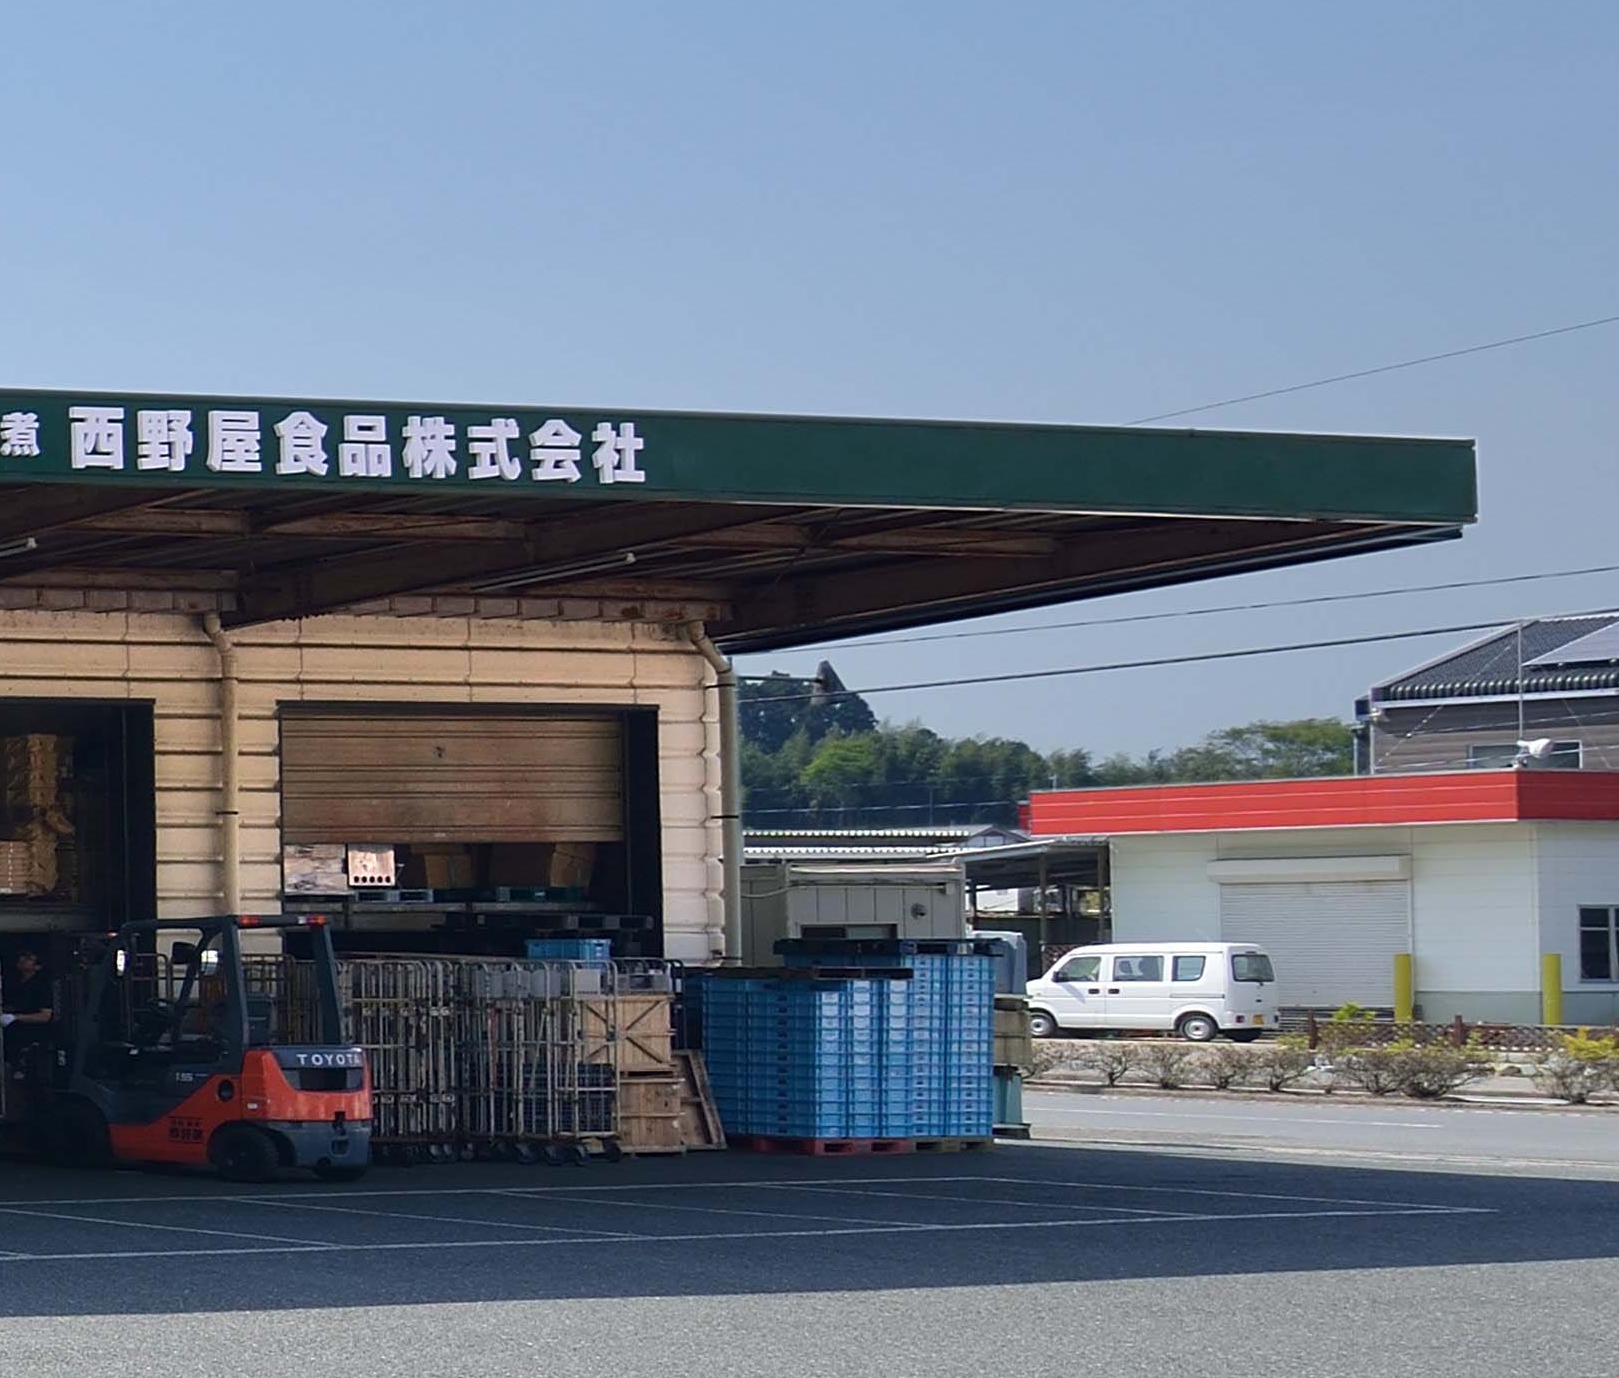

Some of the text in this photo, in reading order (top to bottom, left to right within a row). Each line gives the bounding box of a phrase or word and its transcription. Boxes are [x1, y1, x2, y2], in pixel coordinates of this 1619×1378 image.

[69, 405, 646, 484] 西野屋食品株式会社
[296, 1053, 361, 1065] TOYOTA
